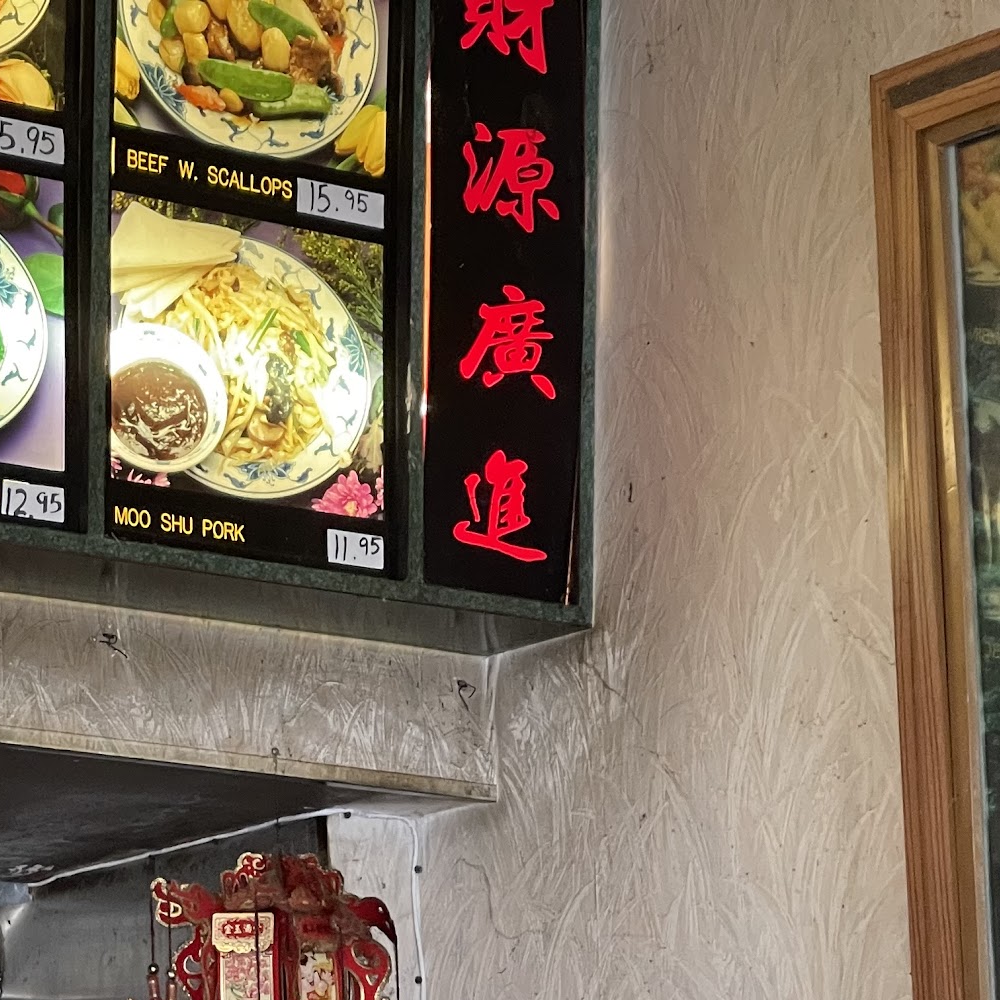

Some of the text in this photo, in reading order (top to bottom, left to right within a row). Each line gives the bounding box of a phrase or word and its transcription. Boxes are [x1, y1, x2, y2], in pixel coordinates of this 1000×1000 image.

[127, 148, 293, 199] BEEF W. SCALLOPS
[310, 181, 368, 213] 15.95
[5, 487, 62, 520] 12.95
[115, 505, 245, 543] MOO SHU PORK
[335, 534, 380, 561] 11.95
